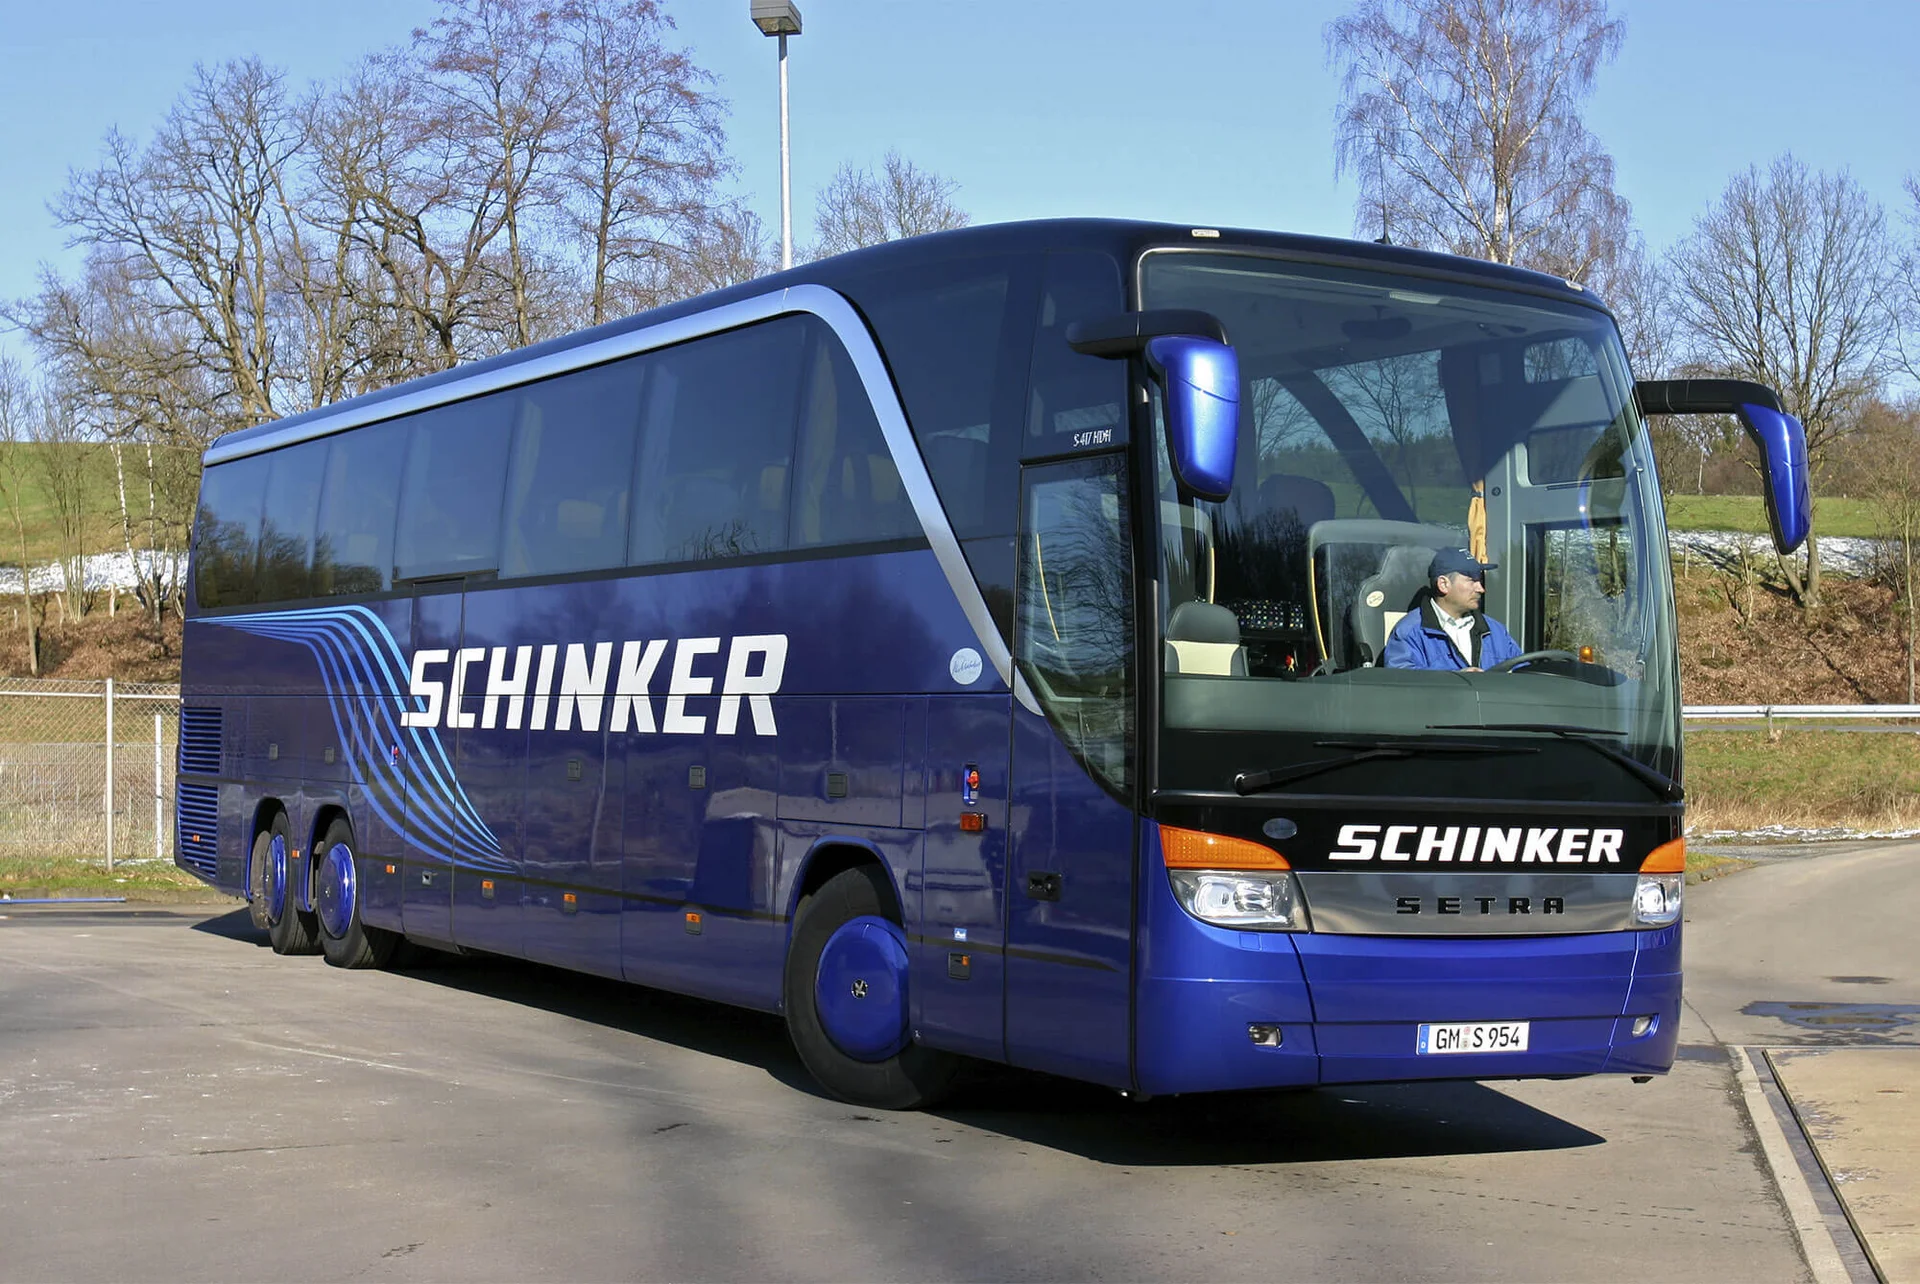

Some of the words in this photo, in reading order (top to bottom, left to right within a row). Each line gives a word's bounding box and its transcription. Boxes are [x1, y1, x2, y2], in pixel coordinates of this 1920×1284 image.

[400, 633, 789, 737] SCHINKER
[1328, 824, 1624, 863] SCHINKER
[1396, 897, 1565, 915] SETRA
[1436, 1028, 1461, 1049] GM
[1472, 1027, 1484, 1048] S
[1488, 1026, 1520, 1048] 954
